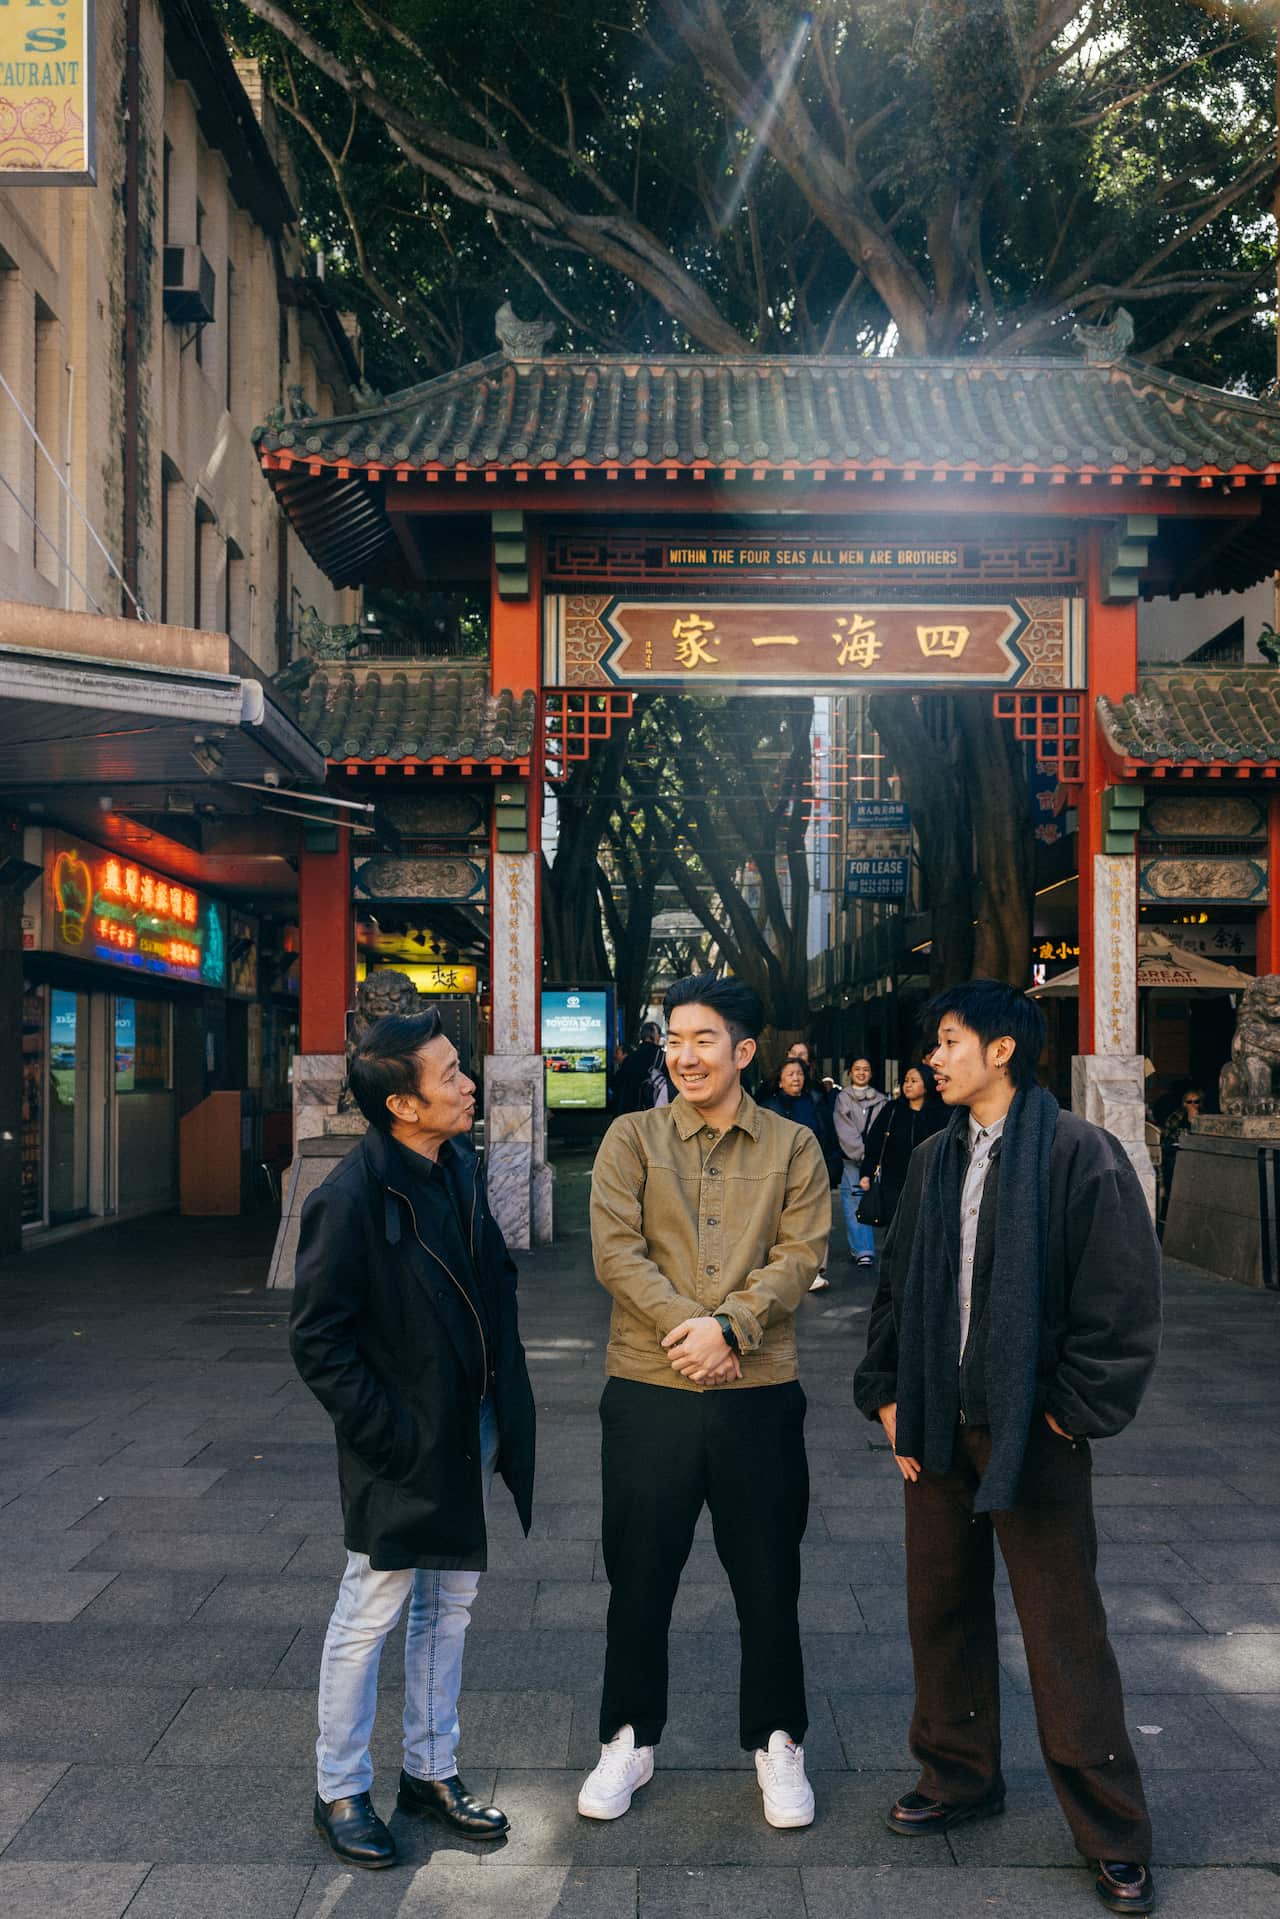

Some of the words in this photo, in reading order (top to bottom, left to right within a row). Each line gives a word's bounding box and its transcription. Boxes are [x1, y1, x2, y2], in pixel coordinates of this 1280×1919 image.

[670, 549, 707, 564] WITHIN
[712, 549, 734, 564] THE
[740, 549, 770, 564] FOUR
[776, 549, 806, 564] SEAS
[812, 549, 834, 564] ALL
[839, 549, 864, 564] MEN
[870, 549, 892, 564] ARE
[898, 549, 957, 564] BROTHERS
[850, 862, 869, 874] FOR
[872, 862, 903, 874] LEASE
